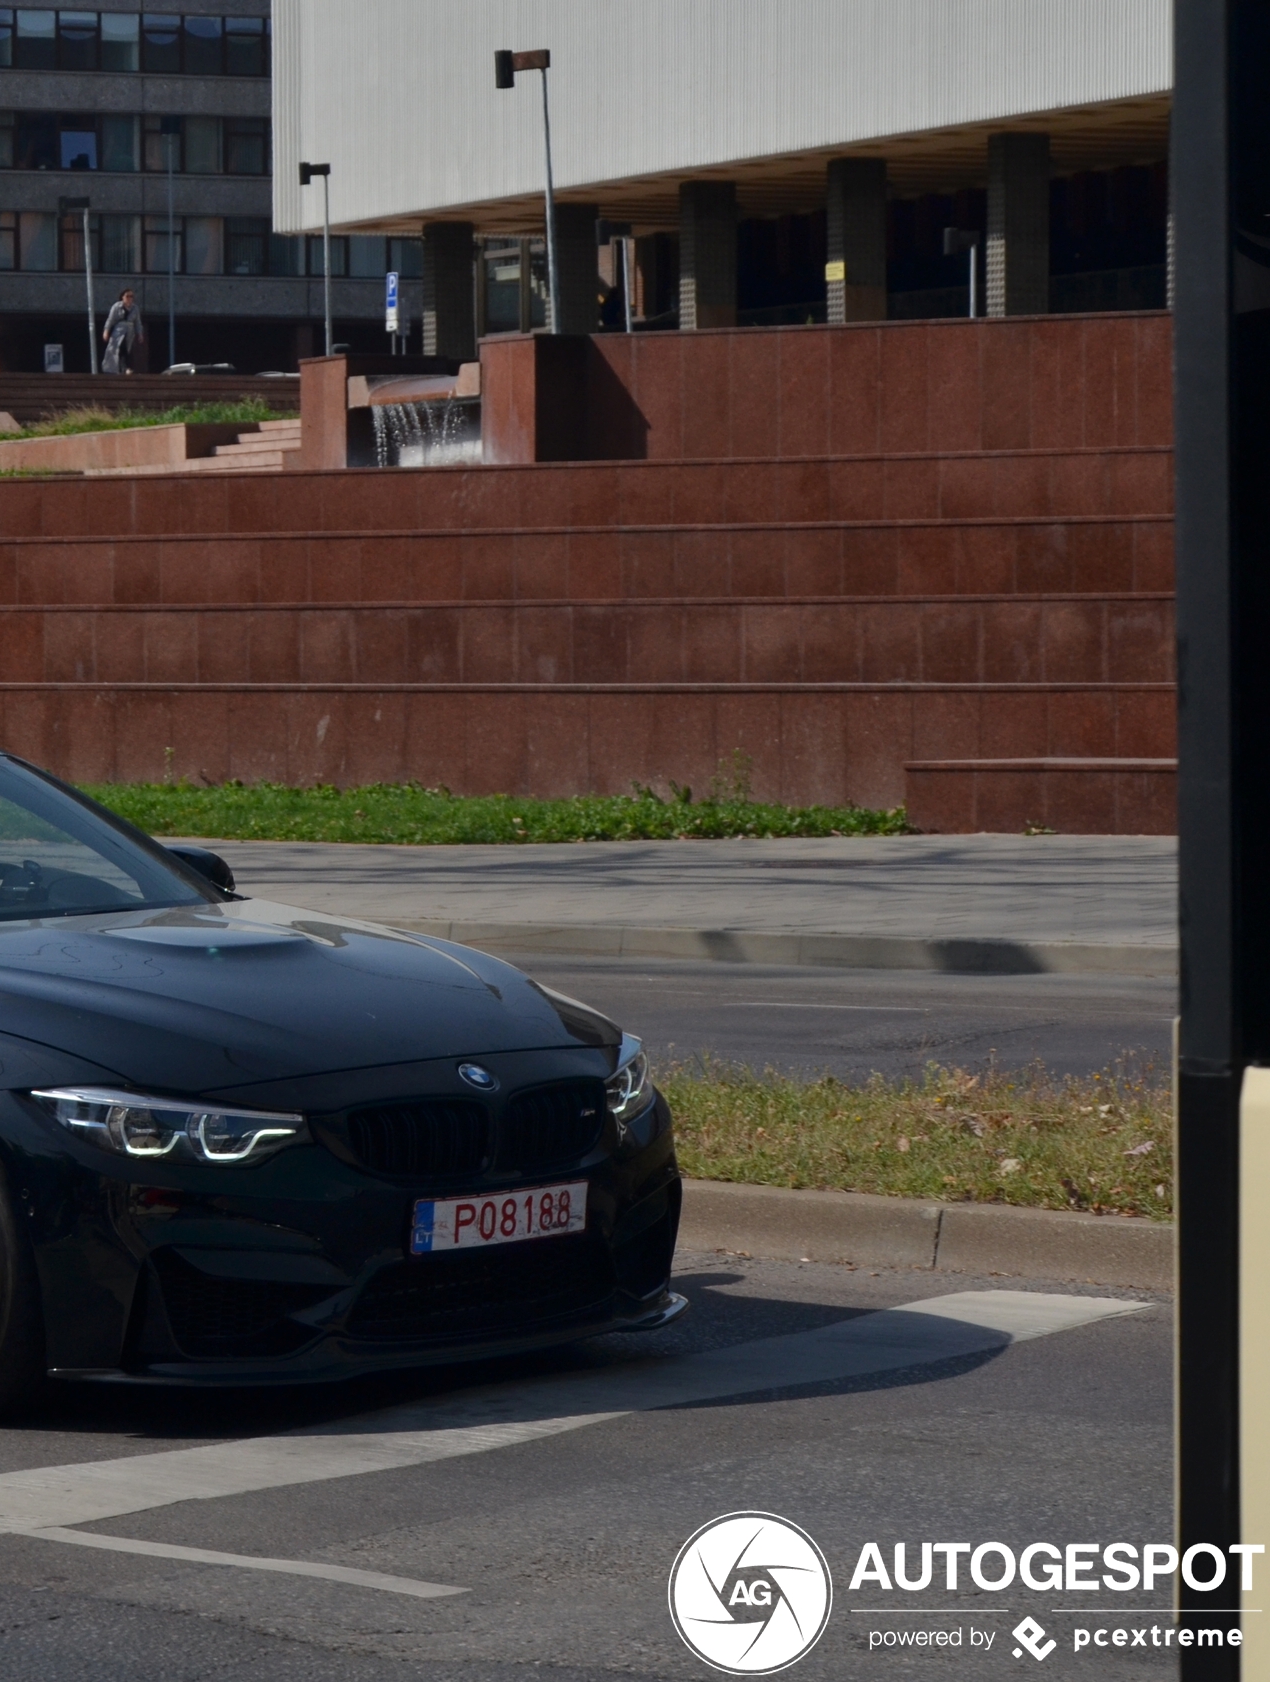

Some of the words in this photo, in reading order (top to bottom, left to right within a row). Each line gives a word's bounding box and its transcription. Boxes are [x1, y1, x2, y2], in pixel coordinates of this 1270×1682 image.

[389, 275, 396, 294] P
[454, 1190, 571, 1243] P08188
[415, 1232, 431, 1244] LT
